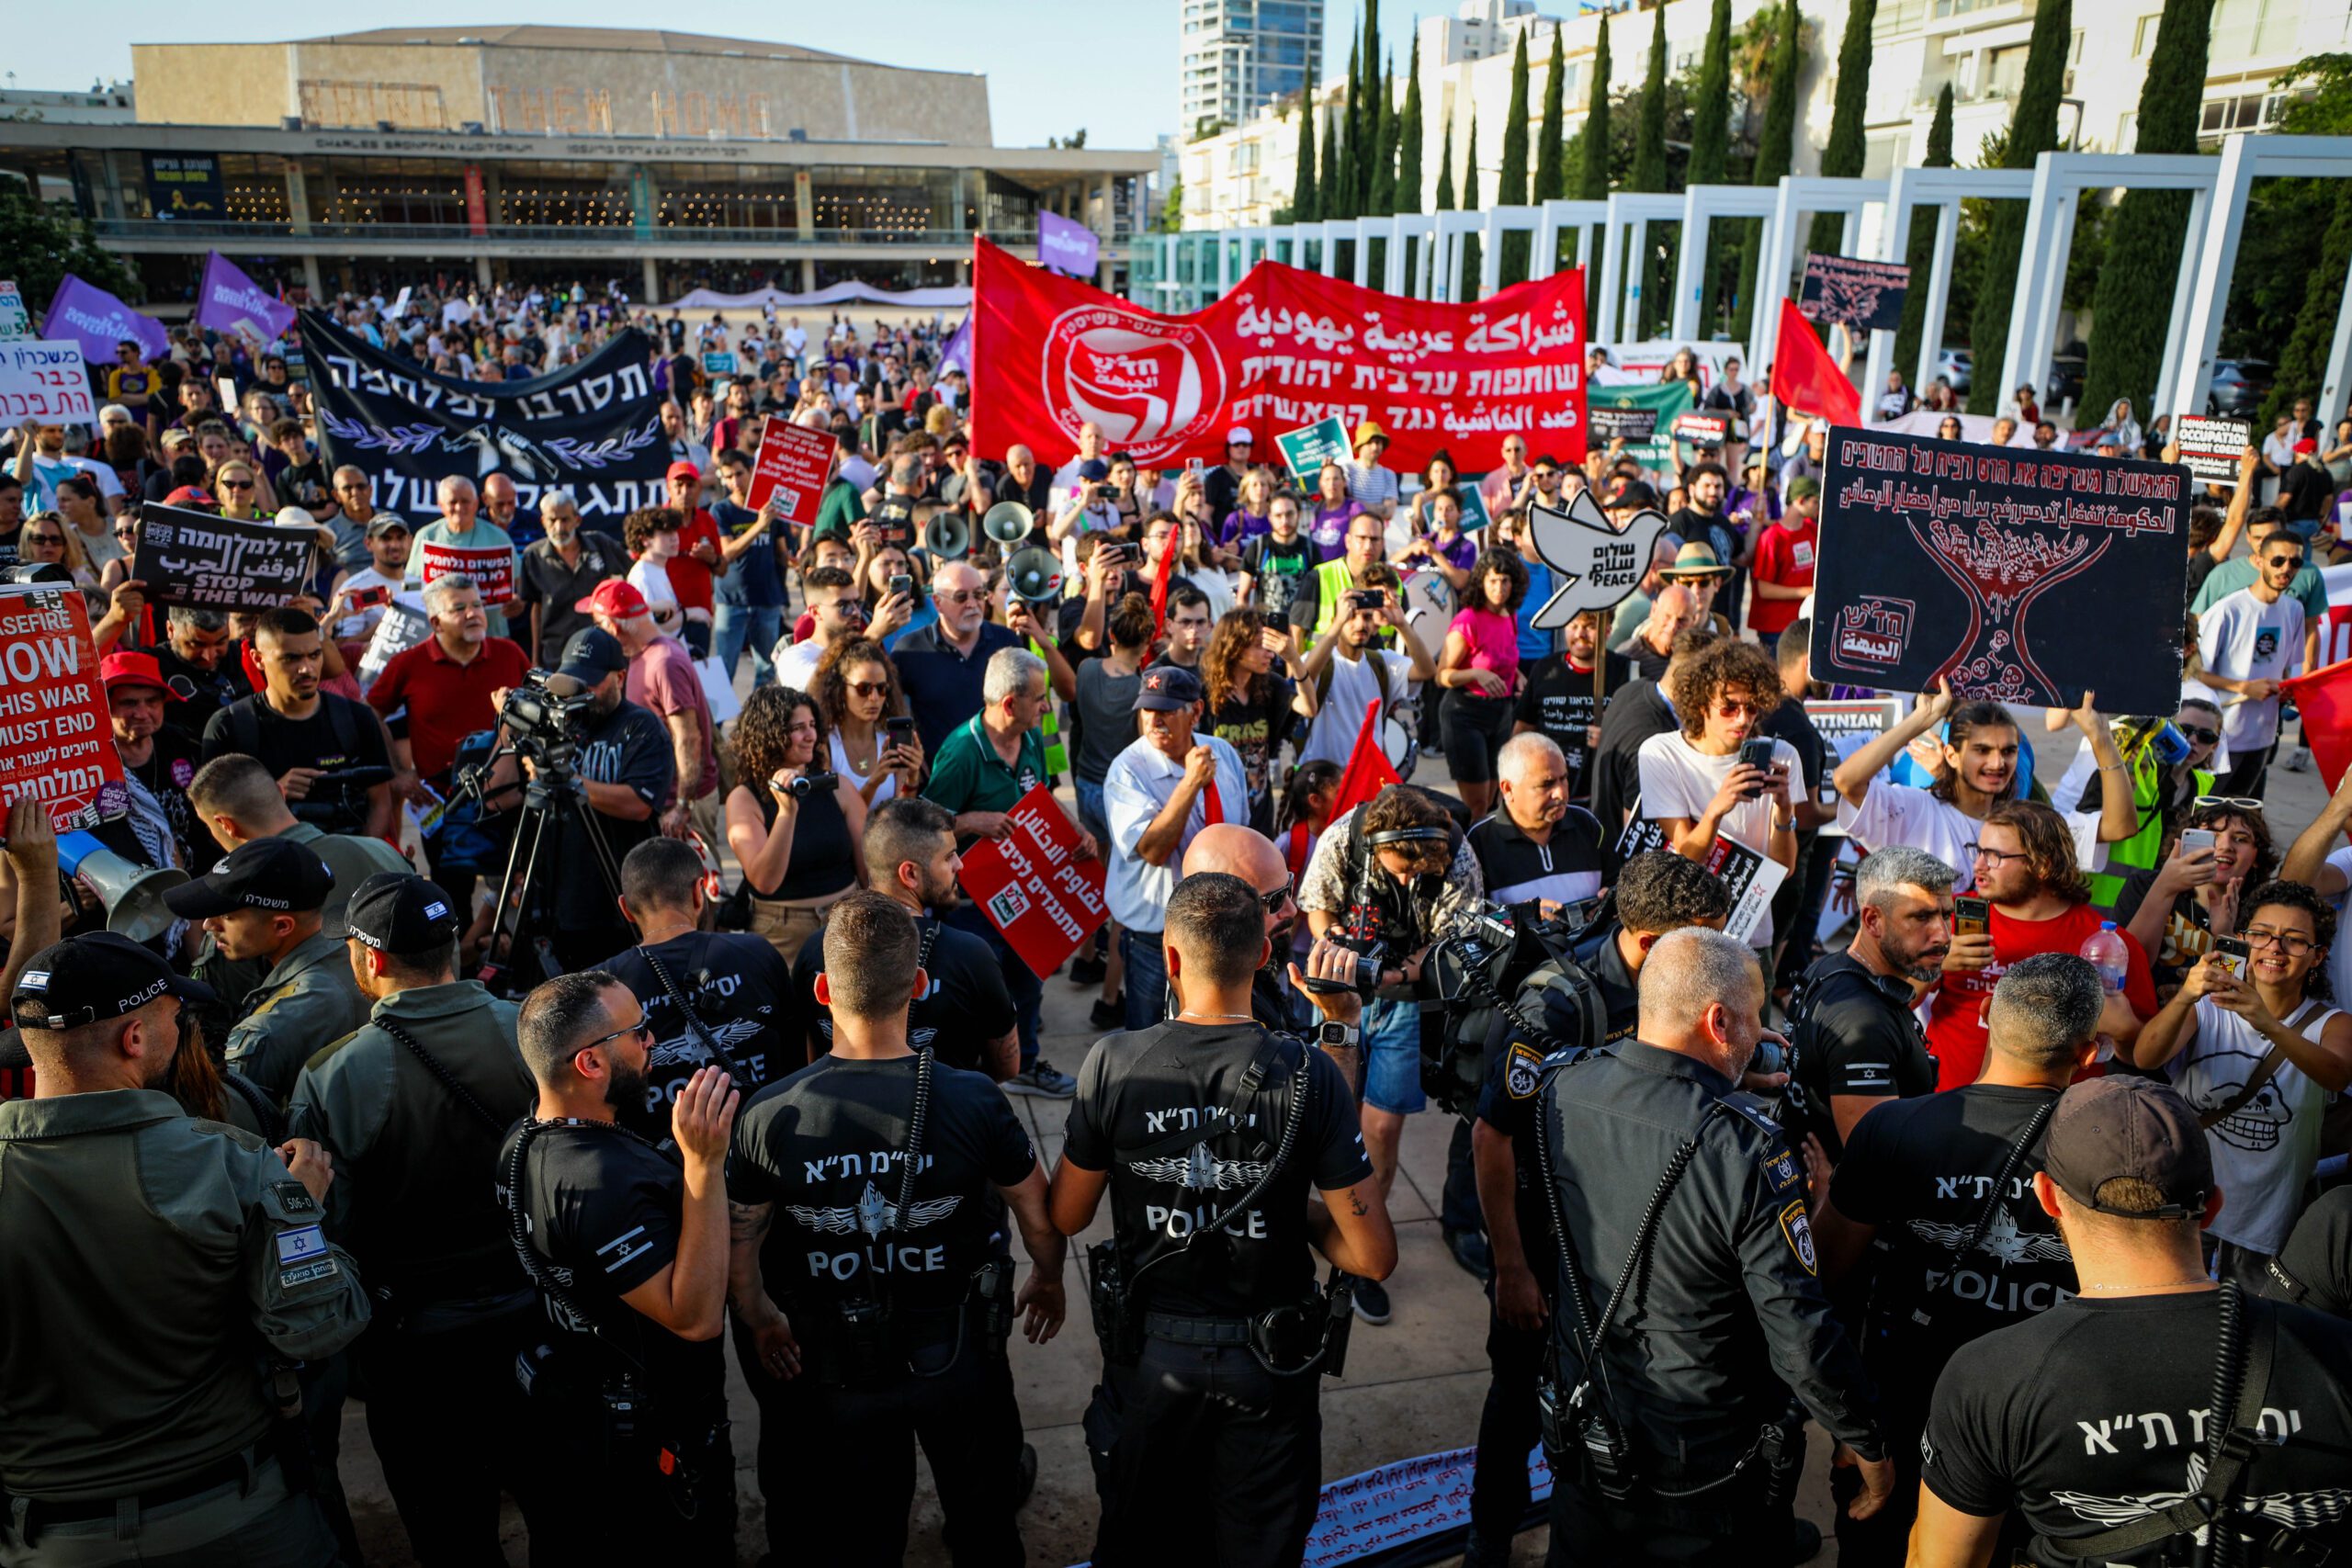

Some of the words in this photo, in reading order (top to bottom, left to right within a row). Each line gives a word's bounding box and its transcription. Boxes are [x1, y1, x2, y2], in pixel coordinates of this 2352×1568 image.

[488, 85, 613, 133] THEM
[652, 89, 771, 138] HOME
[316, 139, 379, 149] CHARLES
[385, 141, 455, 151] BRONFMAN
[459, 142, 533, 153] AUDITORIUM
[1236, 292, 1354, 355] يهودية
[1363, 311, 1453, 364] عربية
[1464, 299, 1576, 355] شراكة
[15, 347, 79, 370] משכרון
[1239, 355, 1343, 389] יהודית
[31, 370, 83, 386] כבר
[327, 355, 494, 420] למלחמה
[516, 362, 648, 422] תסרבו
[1351, 365, 1458, 396] ערבית
[1466, 363, 1579, 397] שותפות
[1231, 393, 1368, 427] הפאשיזם
[1386, 406, 1436, 430] נגד
[1440, 400, 1533, 439] الفاشية
[1539, 400, 1577, 429] ضد
[2180, 418, 2231, 432] DEMOCRACY
[2178, 428, 2248, 446] OCCUPATION
[1840, 439, 1907, 473] החטופים
[1910, 443, 1934, 476] על
[1936, 451, 1973, 480] רפיח
[2012, 461, 2038, 488] את
[2040, 464, 2102, 495] מעדיפה
[2106, 467, 2180, 501] הממשלה
[2106, 505, 2176, 537] الحكومة
[178, 526, 281, 557] למלחמה
[285, 540, 308, 557] די
[1593, 542, 1636, 558] שלום
[159, 544, 242, 577] الحرب
[243, 557, 307, 583] أوقف
[423, 552, 465, 568] נלחמים
[489, 567, 506, 581] לא
[1589, 557, 1636, 581] سلام
[194, 573, 255, 591] STOP
[1593, 571, 1636, 588] PEACE
[191, 588, 236, 604] THE
[241, 591, 293, 608] WAR
[1842, 632, 1899, 660] الجبهة
[39, 682, 92, 709] WAR
[55, 712, 96, 737] END
[17, 746, 57, 766] לעצור
[61, 740, 100, 759] חייבים
[2, 764, 106, 808] המלחמה
[1014, 807, 1069, 866] الاحتلال
[992, 837, 1034, 878] לכיבו
[245, 893, 289, 910] משטרה
[1054, 863, 1104, 915] نقاوم
[1026, 874, 1084, 942] מתנגדים
[349, 924, 381, 949] משטרה
[119, 978, 168, 1012] POLICE
[807, 1243, 946, 1280] POLICE
